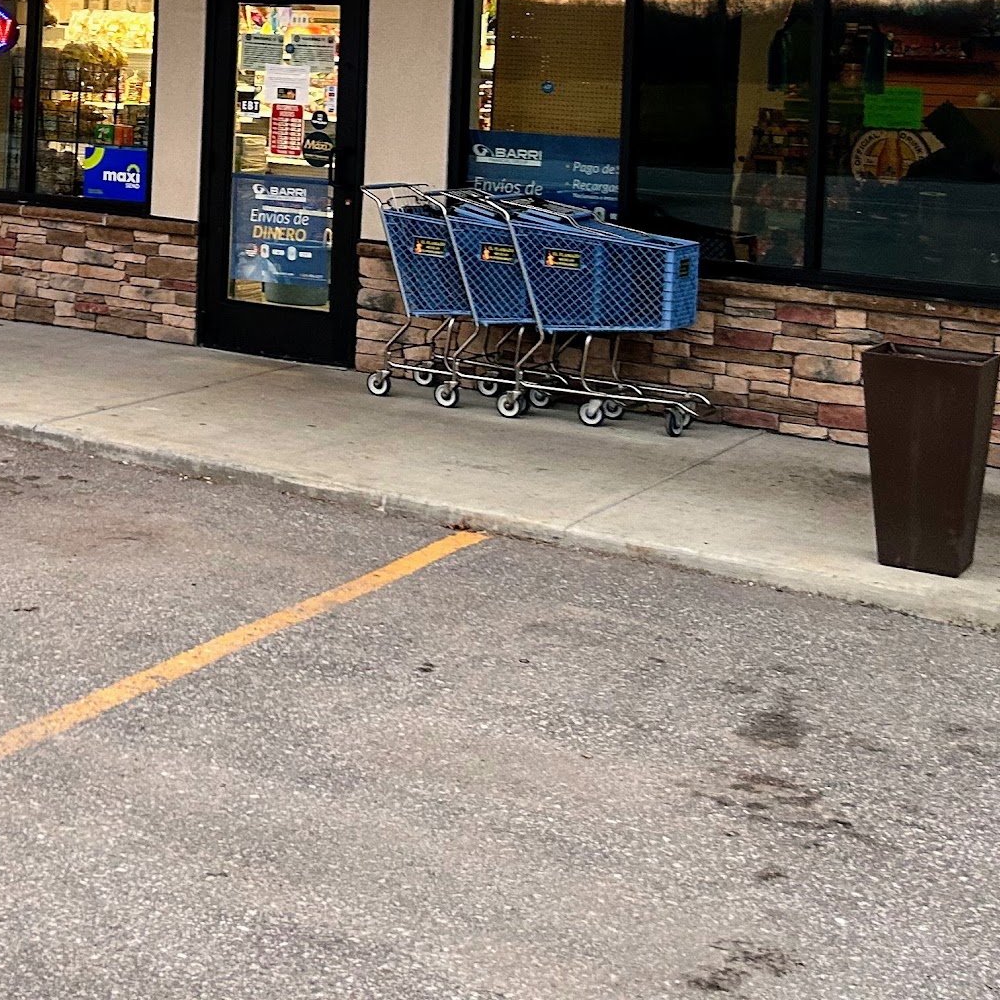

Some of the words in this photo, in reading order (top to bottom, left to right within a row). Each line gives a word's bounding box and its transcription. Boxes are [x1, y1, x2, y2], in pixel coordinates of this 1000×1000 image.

[242, 100, 260, 111] EBT
[495, 147, 542, 160] BARRI
[854, 132, 880, 166] OFFICIAL
[573, 161, 600, 175] Pago
[102, 170, 140, 184] maxi
[270, 186, 306, 197] BARRI
[525, 180, 543, 195] de
[293, 211, 309, 226] de
[252, 225, 306, 242] DINERO
